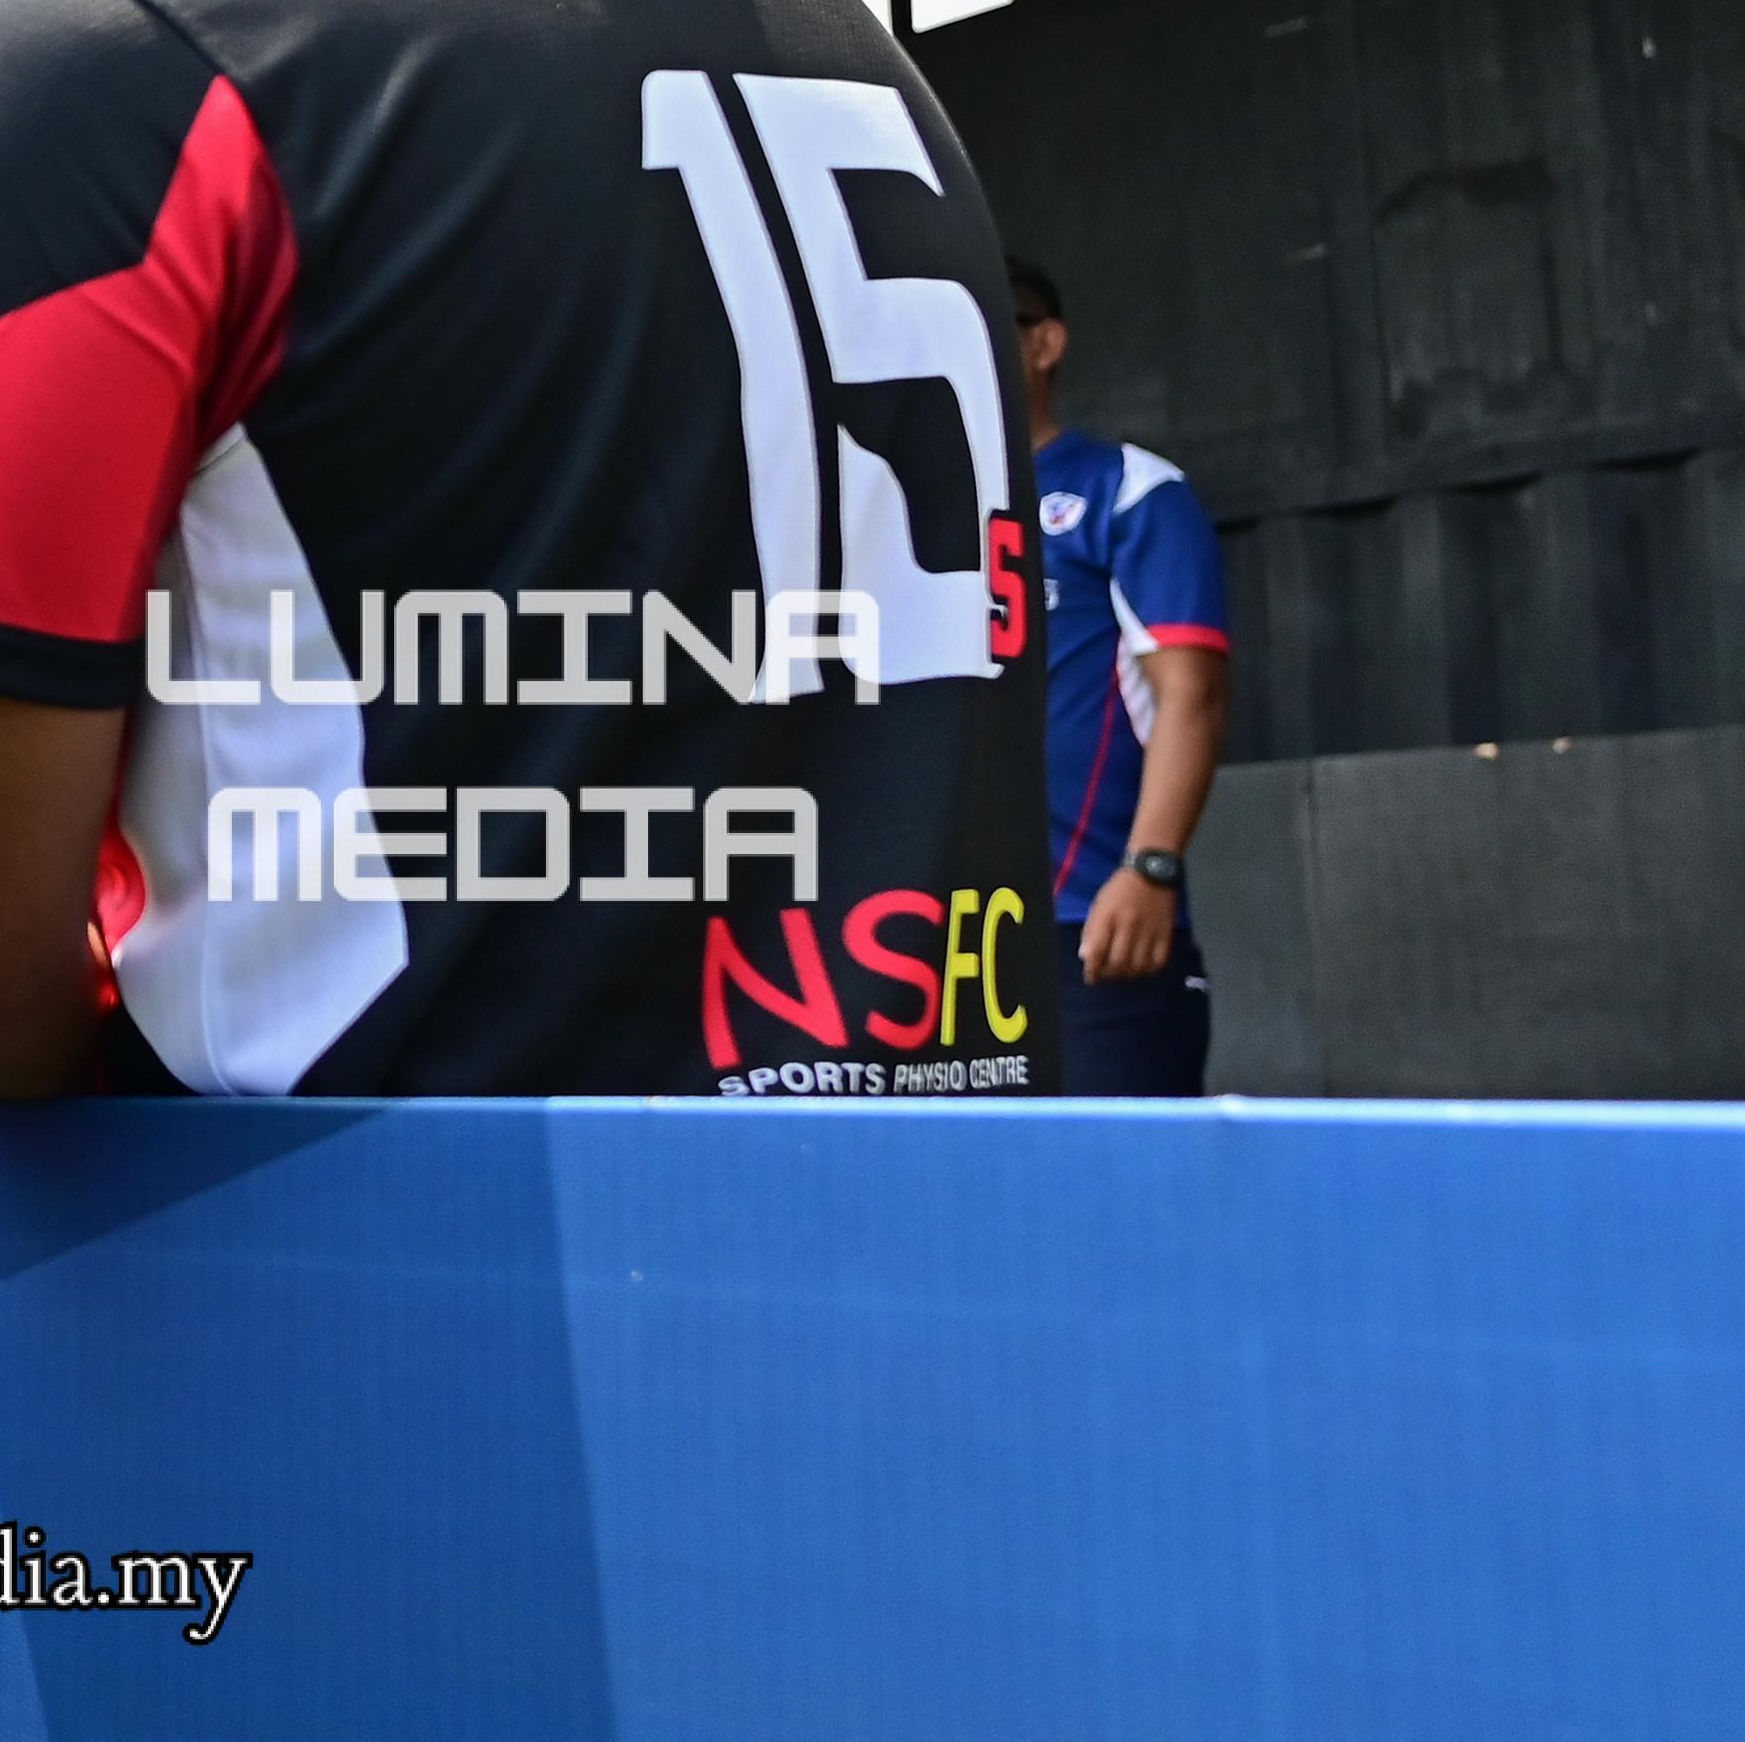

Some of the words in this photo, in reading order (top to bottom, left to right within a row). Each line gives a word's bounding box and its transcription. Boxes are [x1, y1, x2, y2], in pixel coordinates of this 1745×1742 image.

[642, 69, 1009, 701] 15
[702, 887, 1028, 1069] NSFC
[718, 1061, 886, 1097] SPORTS
[893, 1059, 967, 1095] PHYSIO
[969, 1055, 1030, 1089] CENTRE
